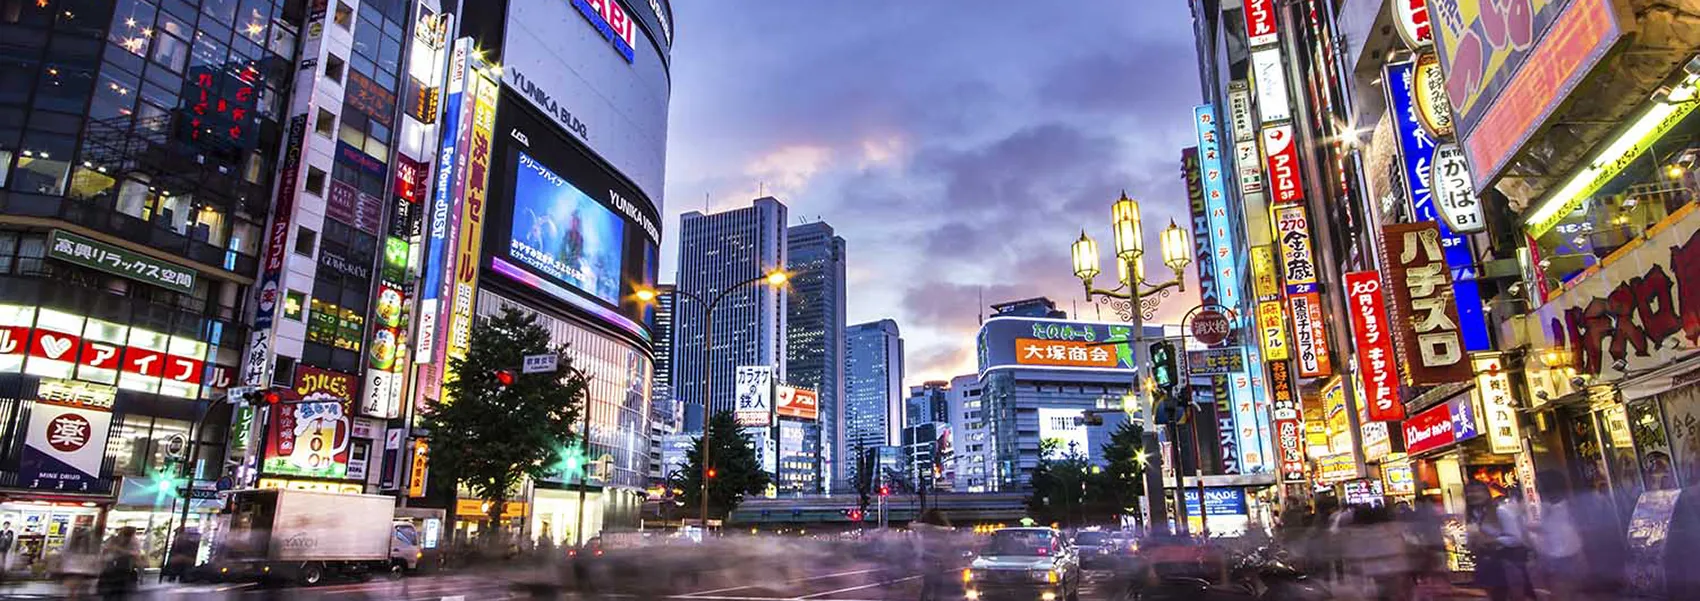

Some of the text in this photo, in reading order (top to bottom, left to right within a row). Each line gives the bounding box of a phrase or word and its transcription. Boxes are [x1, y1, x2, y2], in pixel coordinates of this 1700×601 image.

[511, 67, 589, 141] YUNIKA BLDG.
[1273, 155, 1295, 190] アコム
[609, 189, 643, 226] YUNIKA
[1280, 191, 1295, 199] 3F
[432, 199, 449, 239] JUST
[1281, 219, 1305, 231] 270
[1457, 214, 1477, 225] B1
[268, 221, 287, 270] アイフル
[1283, 231, 1314, 280] 金の蔵
[1442, 237, 1461, 247] 3F
[54, 237, 192, 288] 高興リラックス空間
[1296, 285, 1311, 293] 2F
[1401, 228, 1462, 367] パチスロ
[1351, 280, 1379, 344] 100円ショップ
[1194, 319, 1228, 335] 消火栓
[1293, 298, 1316, 372] 東京チカラめし
[90, 343, 230, 388] アイフル
[1023, 344, 1110, 363] 大塚商会
[1206, 353, 1242, 368] セキネ
[738, 368, 769, 384] カラオケ
[749, 384, 757, 396] の
[740, 395, 765, 409] 鉄人
[50, 417, 84, 446] 薬
[239, 409, 252, 442] レイク
[1184, 491, 1238, 501] SUNADE
